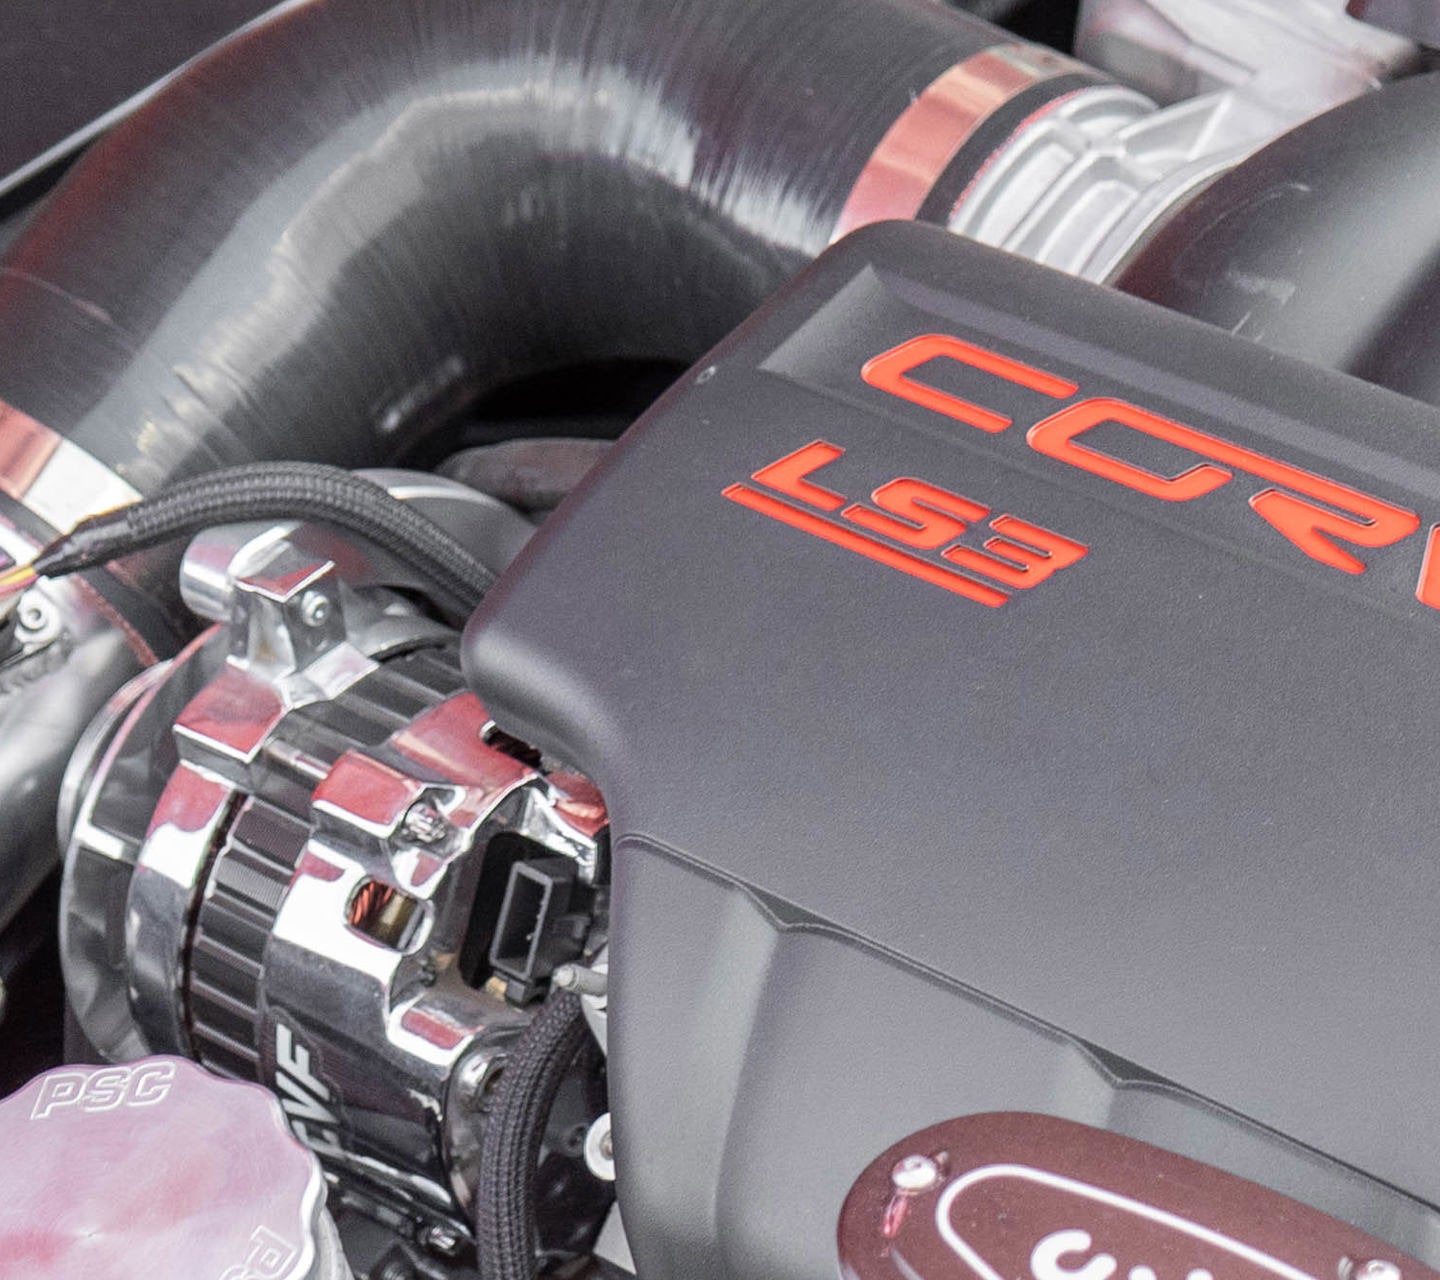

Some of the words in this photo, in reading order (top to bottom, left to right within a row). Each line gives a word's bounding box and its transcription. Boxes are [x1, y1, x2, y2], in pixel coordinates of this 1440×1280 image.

[748, 438, 1091, 592] LS3
[31, 1059, 177, 1120] PSC
[275, 1023, 342, 1158] CVF
